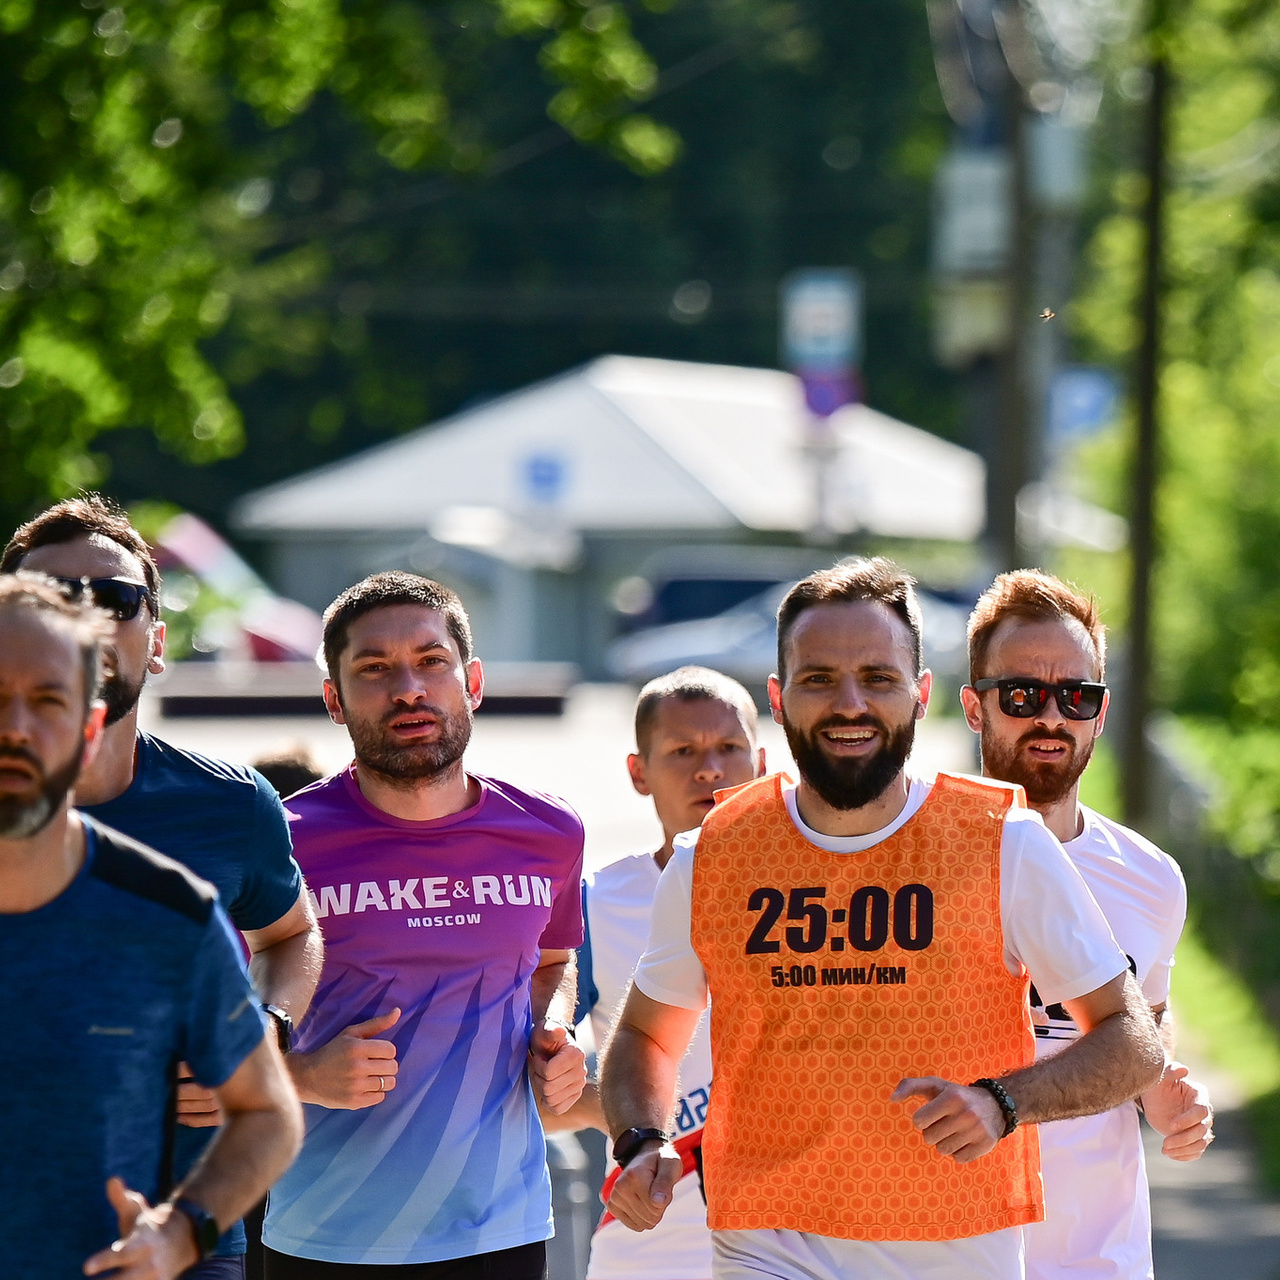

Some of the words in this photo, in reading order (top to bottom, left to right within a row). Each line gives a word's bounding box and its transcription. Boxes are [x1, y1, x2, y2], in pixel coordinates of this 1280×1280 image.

[407, 913, 481, 928] MOSCOW
[745, 883, 934, 955] 25:00
[771, 964, 817, 988] 5:00
